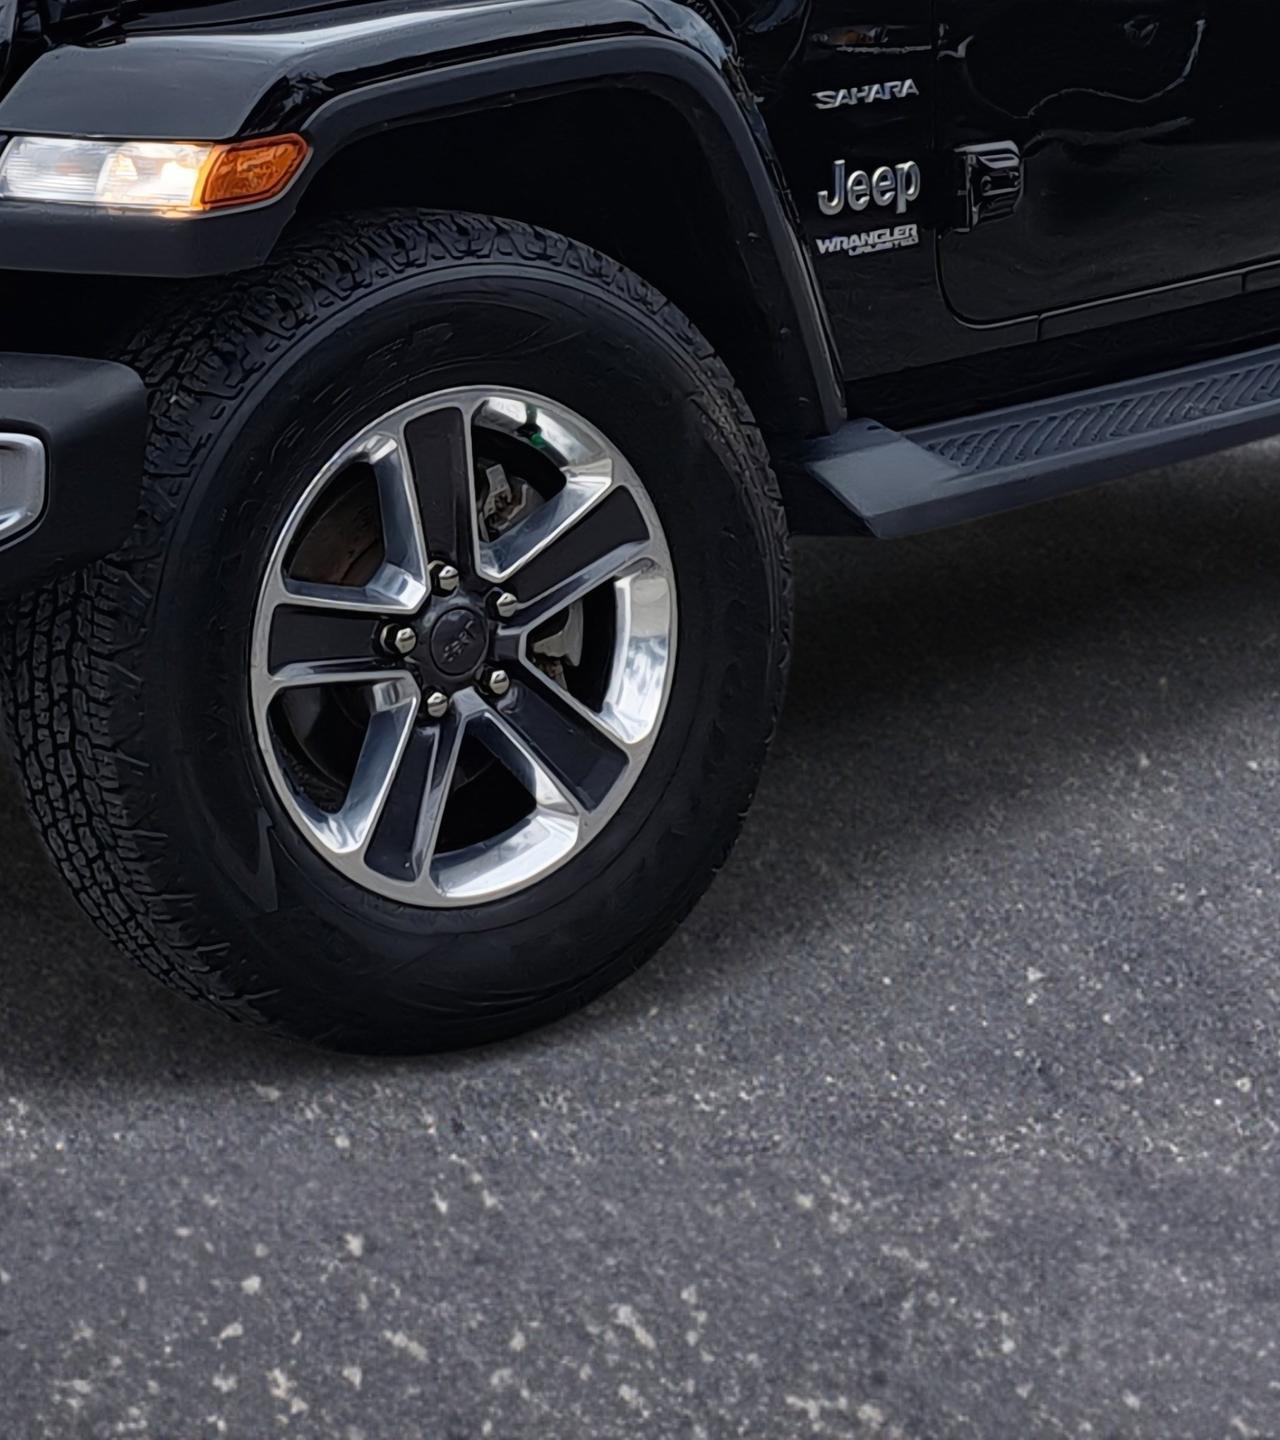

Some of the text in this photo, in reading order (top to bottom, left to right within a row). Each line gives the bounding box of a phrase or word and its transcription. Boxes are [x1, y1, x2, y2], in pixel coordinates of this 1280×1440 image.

[811, 77, 920, 110] SAHARA
[817, 159, 920, 215] Jeep
[815, 223, 918, 254] WRANGLER
